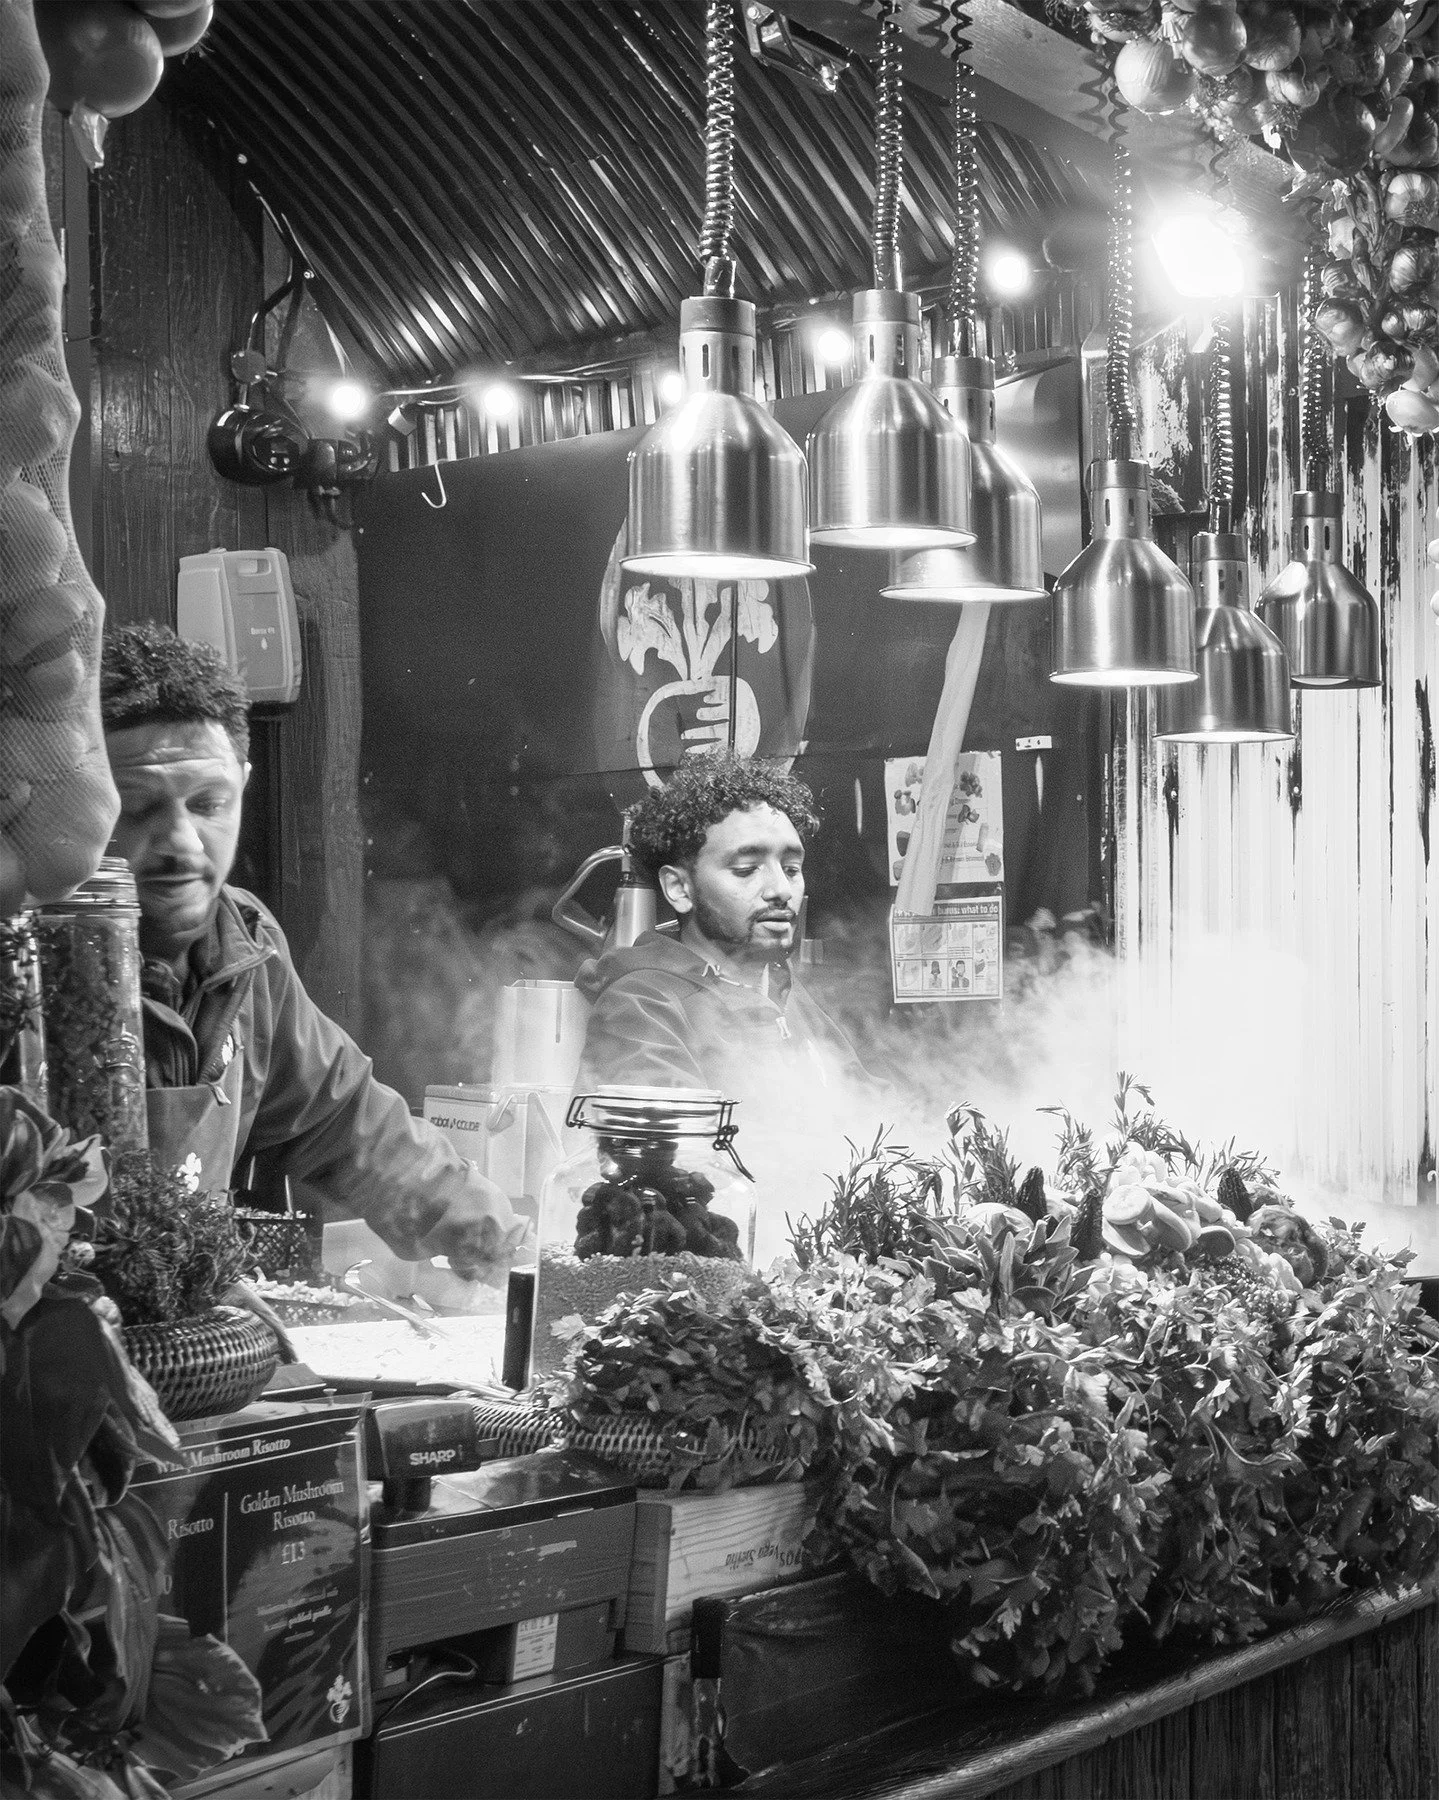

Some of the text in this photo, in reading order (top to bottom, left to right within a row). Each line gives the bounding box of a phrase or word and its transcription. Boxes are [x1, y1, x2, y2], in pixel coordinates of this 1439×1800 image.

[961, 904, 979, 915] what
[980, 904, 988, 914] to
[989, 903, 998, 914] do
[188, 1446, 250, 1468] Mushroom
[252, 1438, 291, 1456] Risotto
[409, 1449, 456, 1466] SHARP
[240, 1480, 344, 1514] Golden Mushroom
[167, 1517, 214, 1540] Risotto
[273, 1509, 315, 1532] Risotto
[281, 1540, 305, 1565] £13
